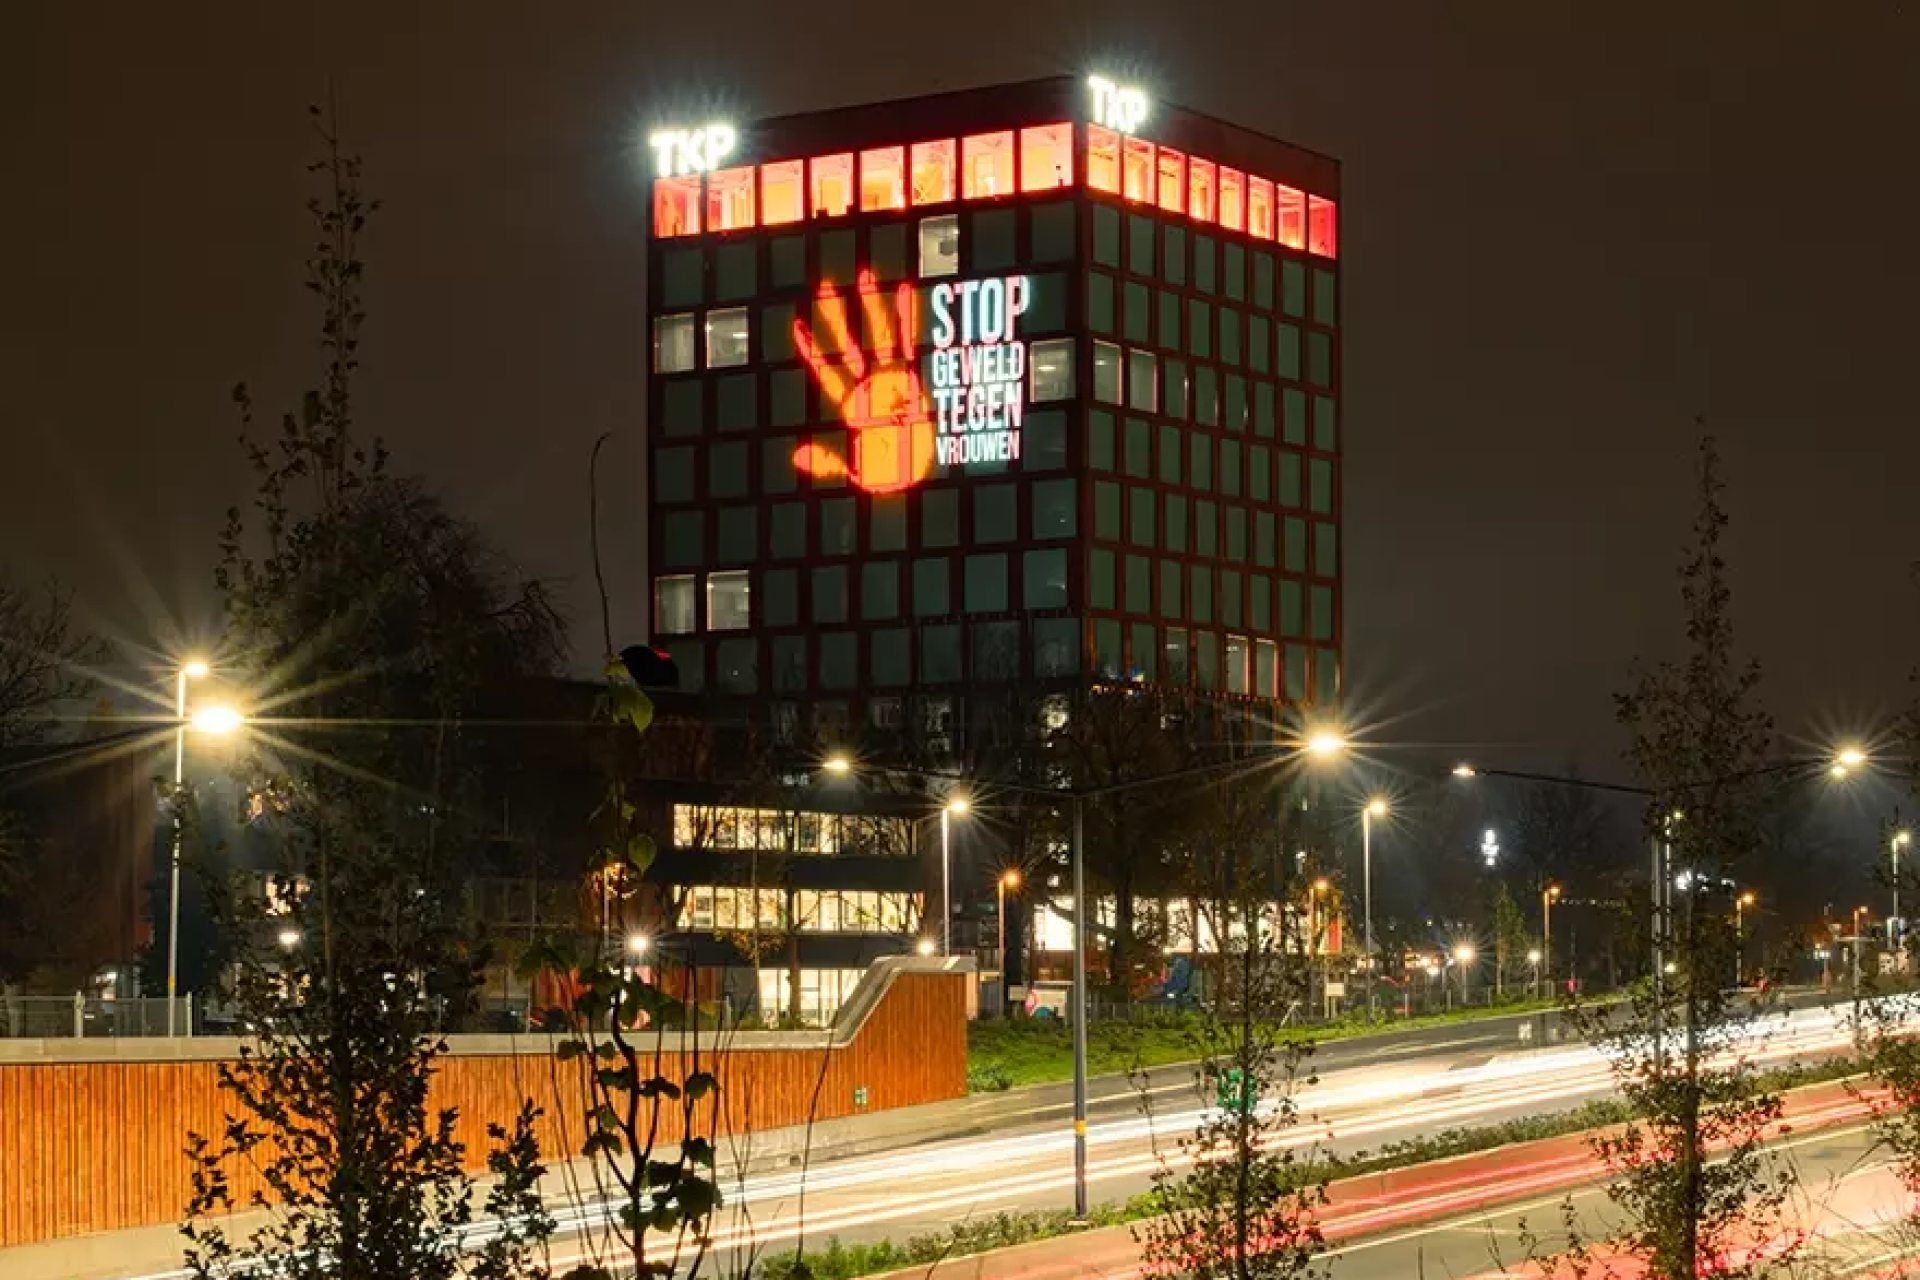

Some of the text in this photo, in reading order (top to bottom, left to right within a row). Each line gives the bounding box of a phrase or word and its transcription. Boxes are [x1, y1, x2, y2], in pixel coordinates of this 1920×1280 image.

[1087, 73, 1147, 134] TKP
[649, 123, 735, 177] TKP
[931, 274, 1031, 348] STOP
[932, 340, 1026, 388] GEWELD
[932, 381, 1023, 433] TEGEN
[936, 429, 1020, 466] VROUWEN
